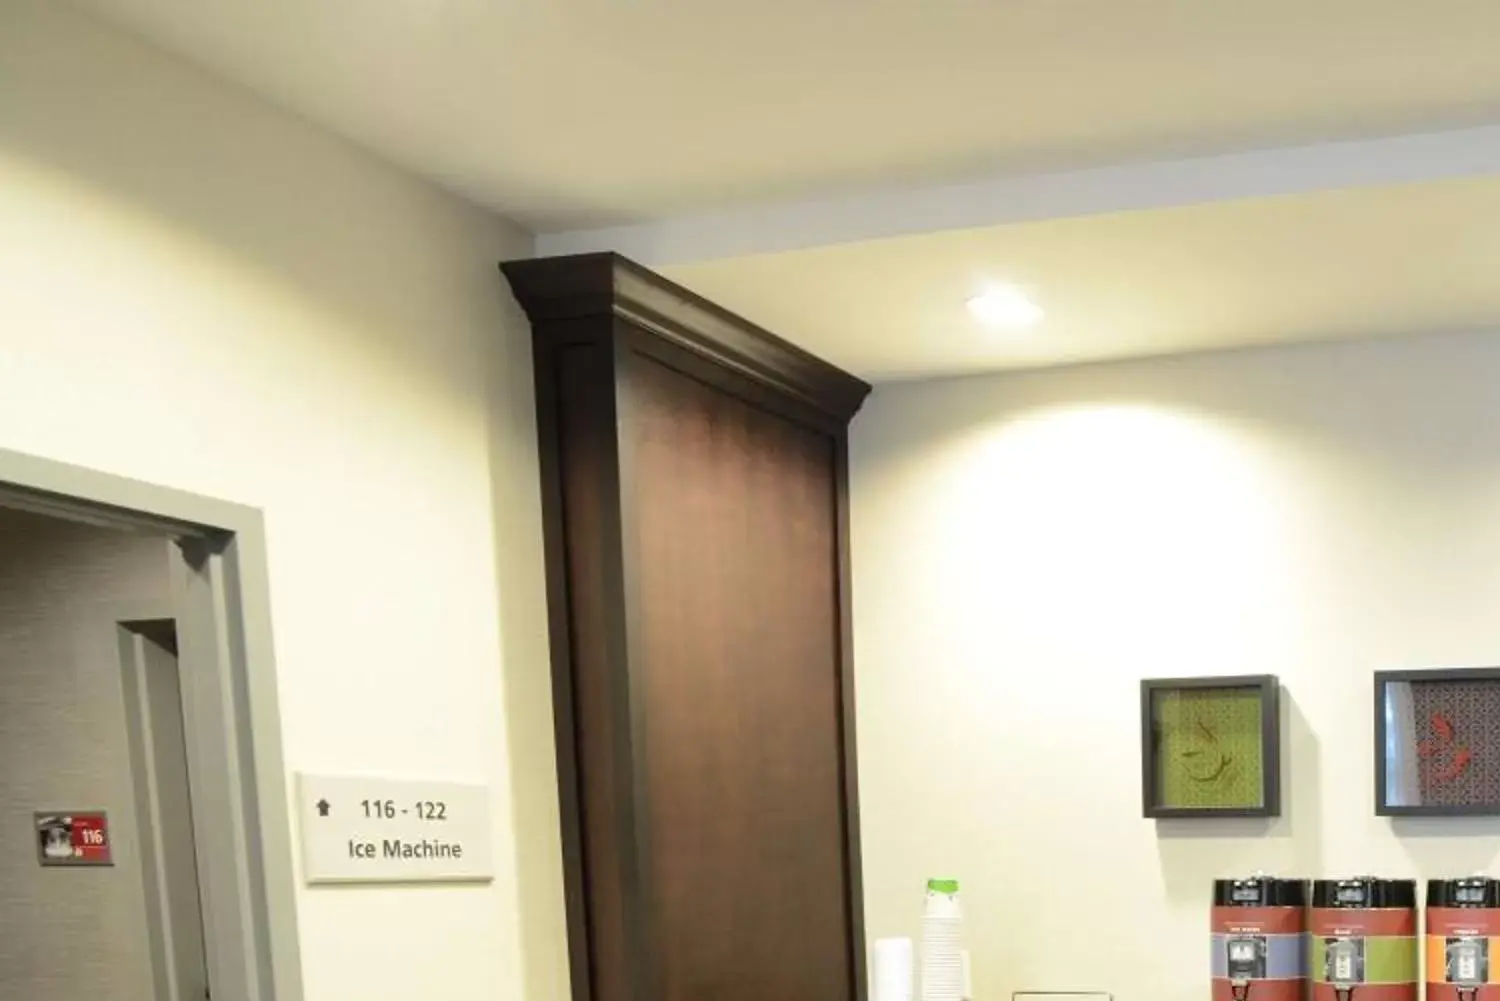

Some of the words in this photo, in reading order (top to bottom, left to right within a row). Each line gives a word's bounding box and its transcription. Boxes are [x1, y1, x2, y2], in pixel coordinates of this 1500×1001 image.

[361, 800, 396, 819] 116
[415, 801, 447, 820] 122
[82, 828, 103, 844] 116
[348, 839, 376, 858] Ice
[383, 839, 462, 858] Machine
